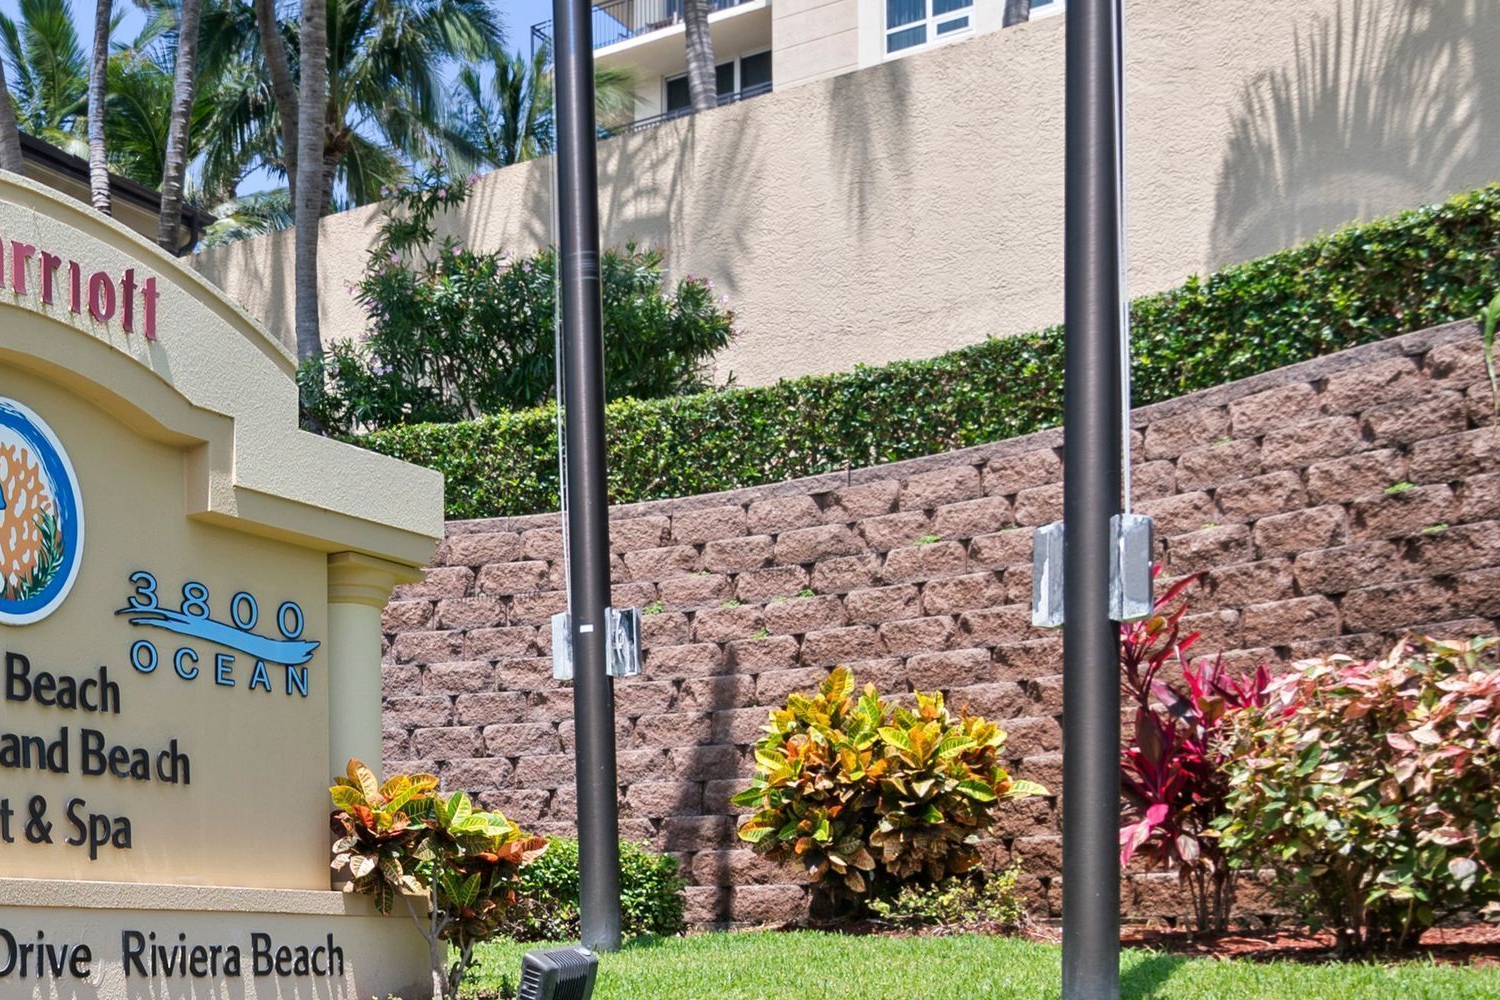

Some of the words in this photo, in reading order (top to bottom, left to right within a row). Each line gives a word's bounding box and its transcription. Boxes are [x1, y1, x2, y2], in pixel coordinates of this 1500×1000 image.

[128, 570, 306, 640] 3800
[4, 651, 122, 715] Beach
[129, 639, 310, 698] OCEAN
[80, 727, 191, 786] Beach
[25, 794, 54, 845] &
[65, 797, 133, 861] Spa
[121, 929, 242, 978] Riviera
[250, 932, 346, 977] Beach
